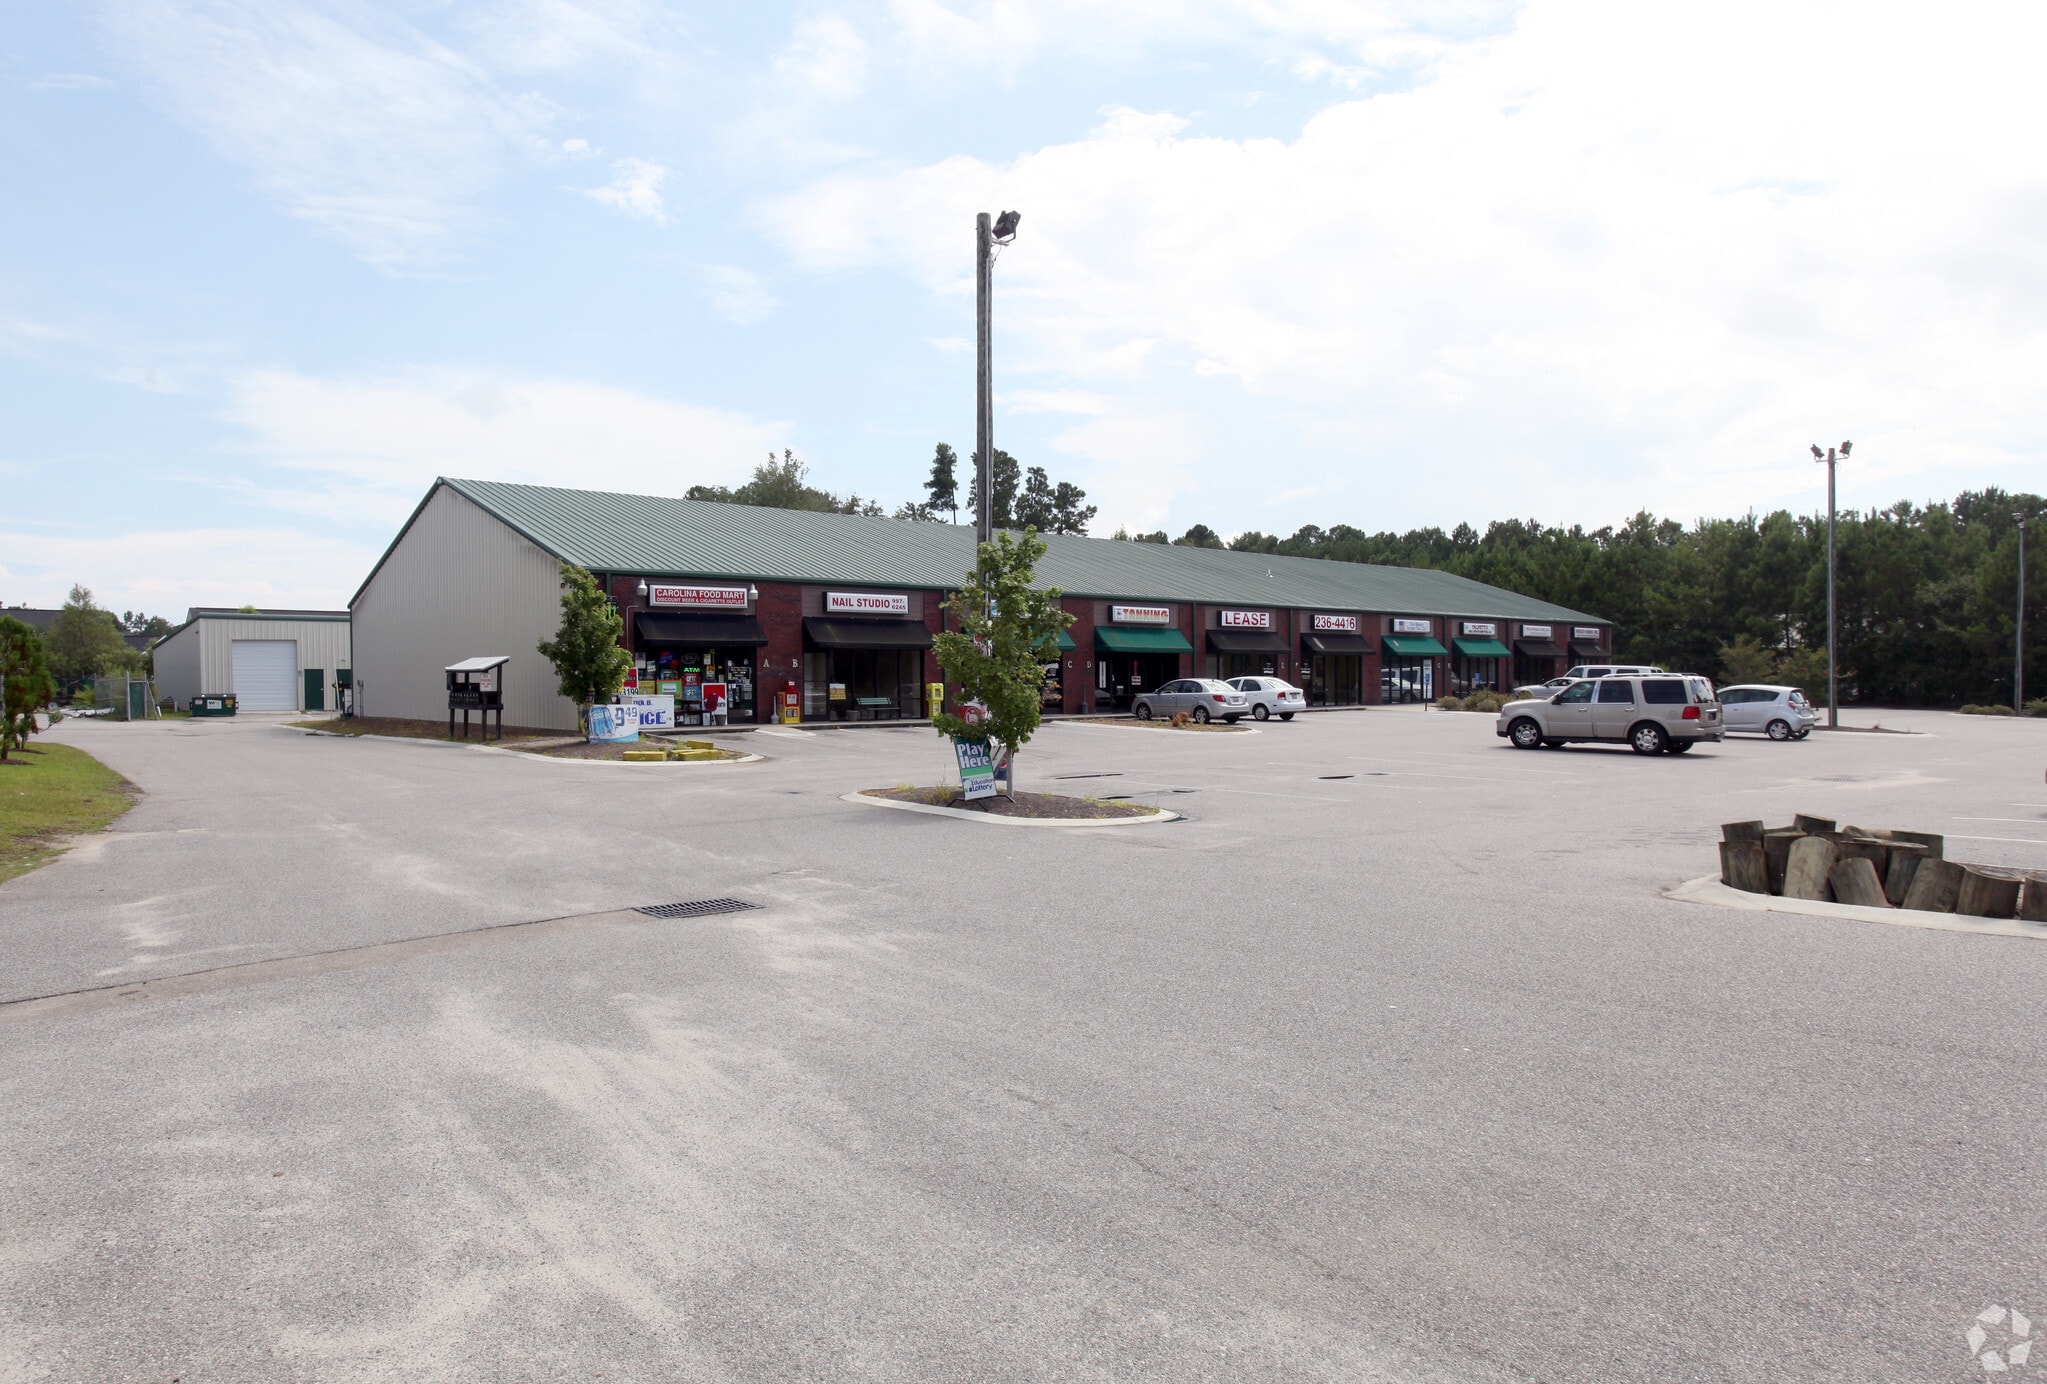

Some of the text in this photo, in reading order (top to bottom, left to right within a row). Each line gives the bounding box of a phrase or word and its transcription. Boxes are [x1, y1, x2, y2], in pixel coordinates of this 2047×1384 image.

[656, 589, 744, 599] CAROLINA FOOD MART
[832, 597, 891, 608] NAIL STUDIO
[1123, 608, 1169, 620] TANNING
[1225, 612, 1267, 626] LEASE
[1315, 616, 1355, 629] 236-4416
[763, 658, 770, 668] A
[792, 658, 799, 668] B
[1067, 660, 1073, 669] C
[639, 711, 667, 725] ICE
[956, 743, 984, 757] Play
[960, 755, 990, 769] Here
[971, 778, 994, 786] Education
[972, 784, 993, 792] Lottery
